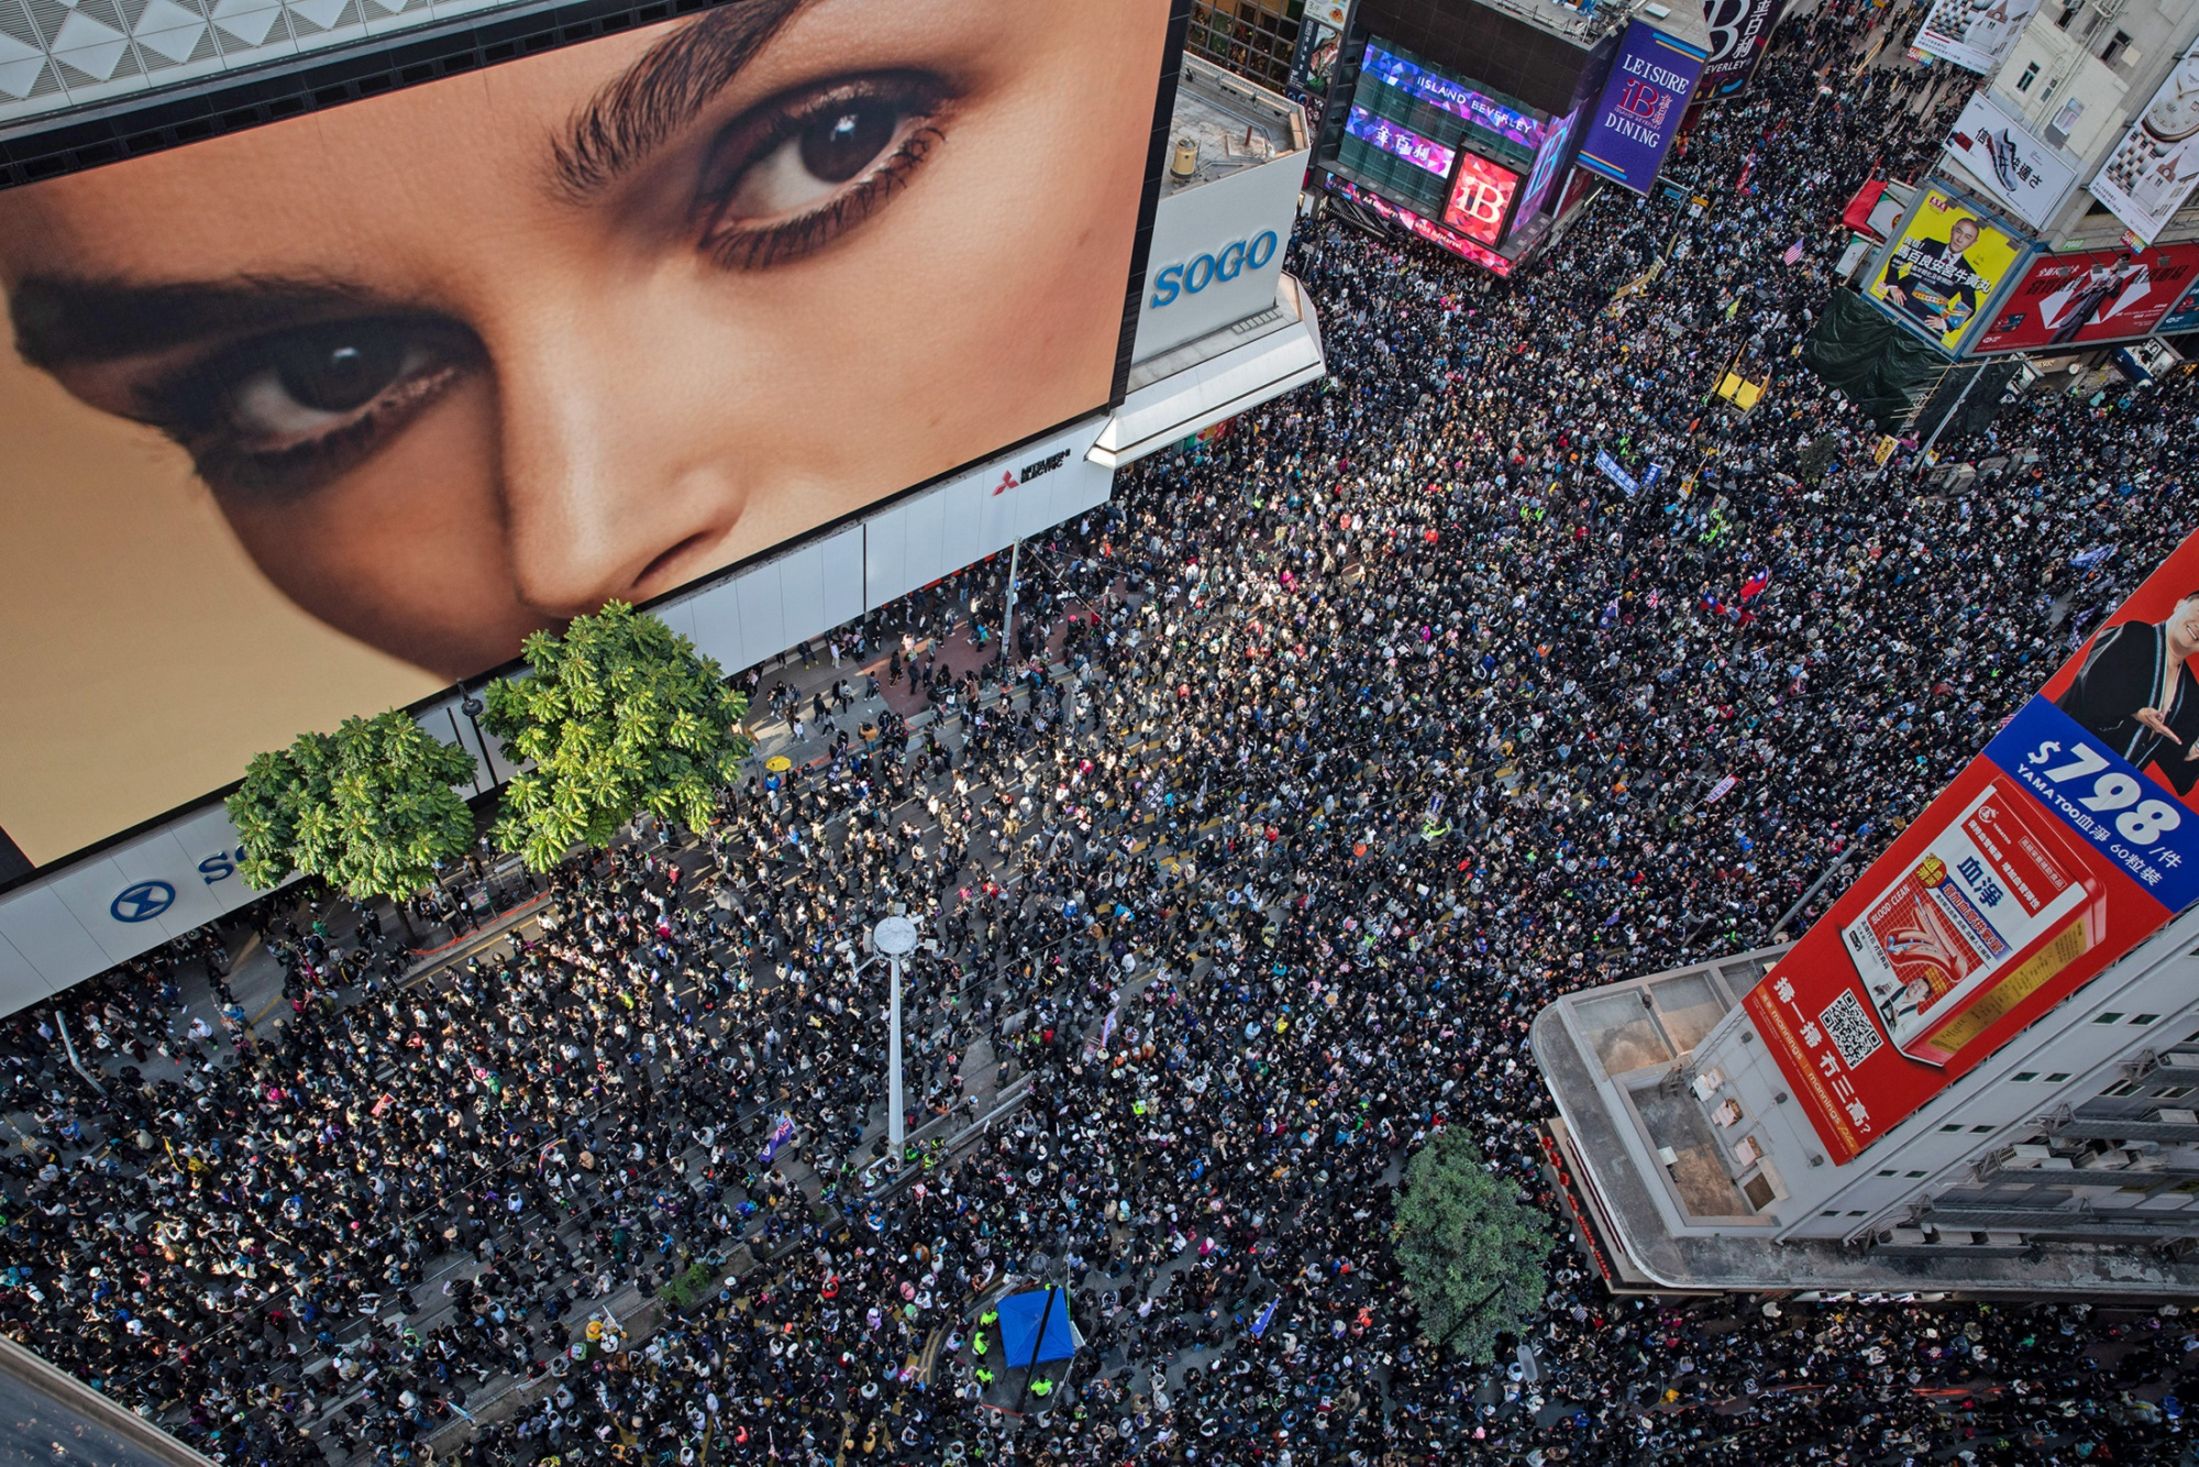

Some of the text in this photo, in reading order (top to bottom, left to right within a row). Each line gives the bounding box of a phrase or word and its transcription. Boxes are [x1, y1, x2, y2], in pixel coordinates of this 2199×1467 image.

[1622, 54, 1689, 95] LEISURE
[1705, 60, 1746, 74] EVERLEY
[1471, 101, 1533, 135] BEVERLEY
[1605, 112, 1660, 149] DINING
[1457, 175, 1504, 224] iB
[1151, 230, 1278, 309] SOGO
[2027, 740, 2181, 846] $798
[199, 844, 249, 886] S
[1956, 855, 2005, 908] 血淨
[2110, 843, 2163, 886] 60粒裝
[1871, 884, 1910, 924] BLOOD CLEAN
[1773, 976, 1822, 1049] 掃一掃
[1771, 1010, 1803, 1061] mannings
[1807, 1072, 1841, 1125] mannings
